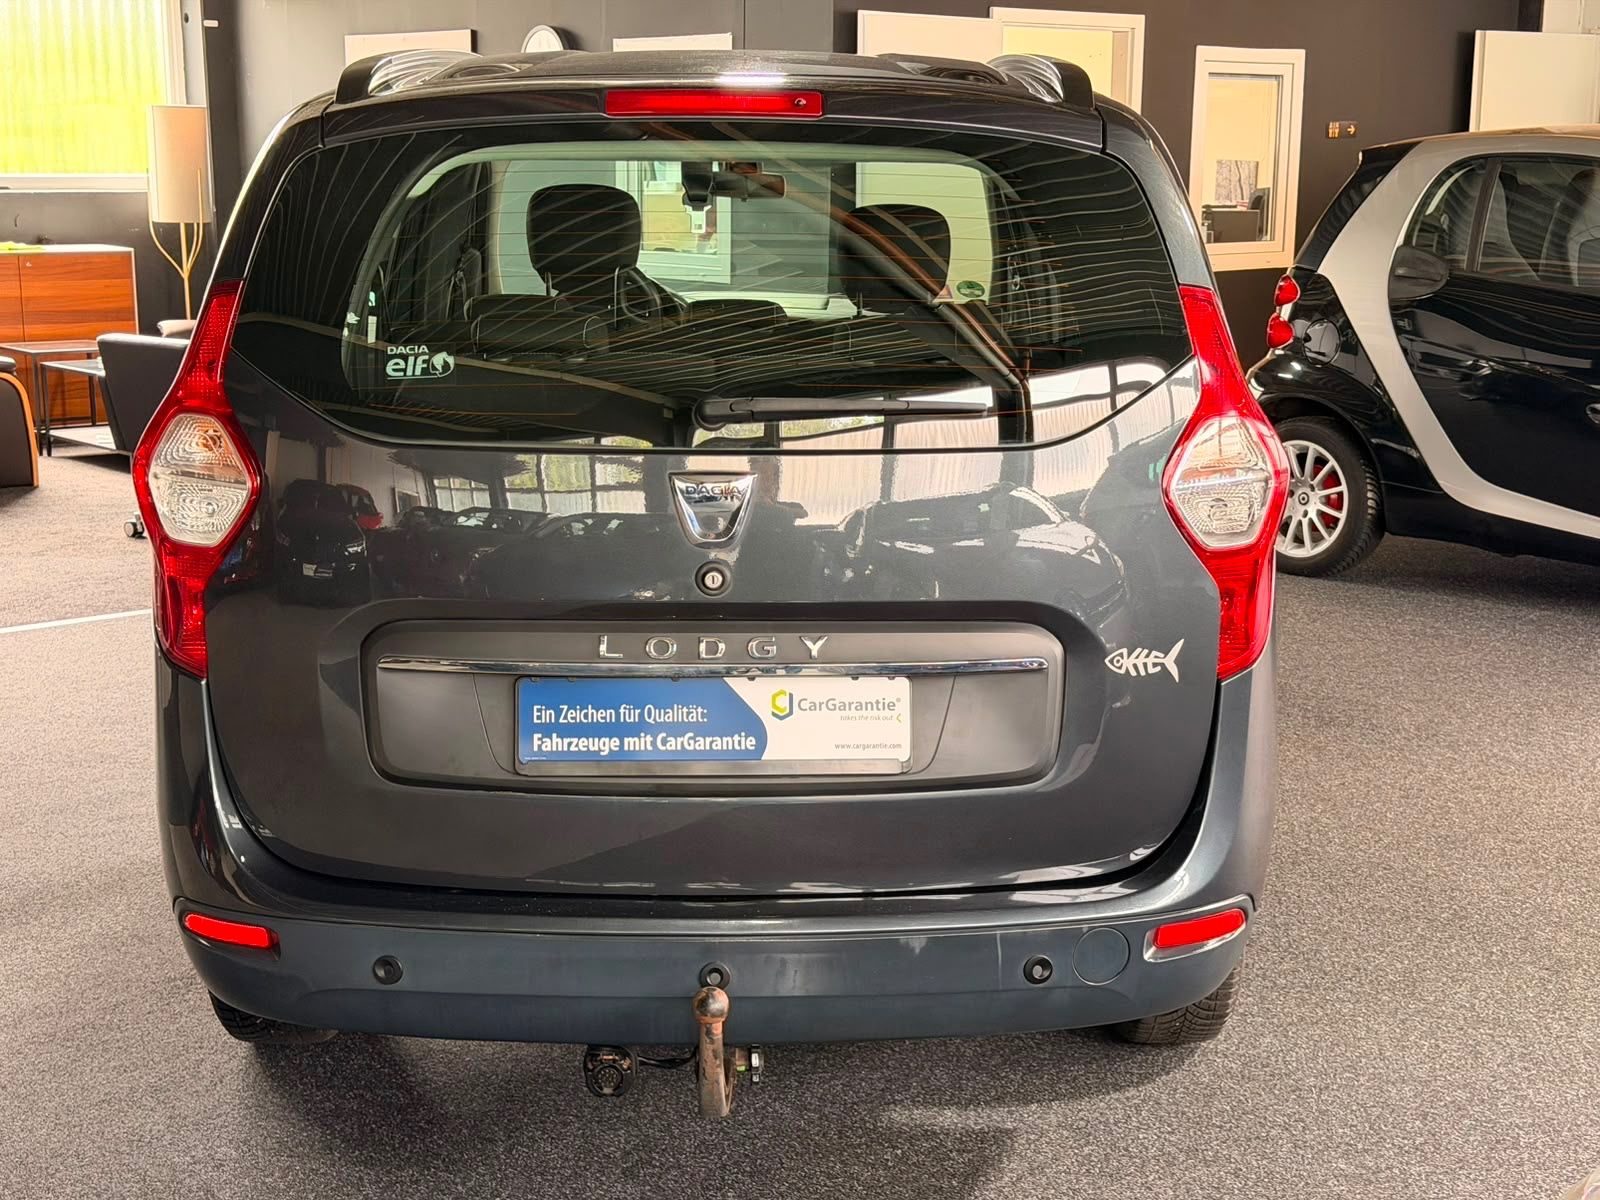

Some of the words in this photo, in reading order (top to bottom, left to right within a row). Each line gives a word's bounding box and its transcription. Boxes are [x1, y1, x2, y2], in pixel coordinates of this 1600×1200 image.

[387, 345, 429, 355] DACIA
[386, 355, 429, 377] elf
[685, 485, 742, 497] DACIA
[599, 634, 828, 660] LODGY
[533, 705, 555, 723] Ein
[559, 704, 616, 723] Zeichen
[619, 704, 640, 723] für
[644, 703, 708, 724] Qualität:
[533, 733, 620, 756] Fahrzeuge
[624, 732, 653, 751] mit
[656, 732, 757, 751] CarGarantie
[834, 743, 902, 751] www.cargarantie.com
